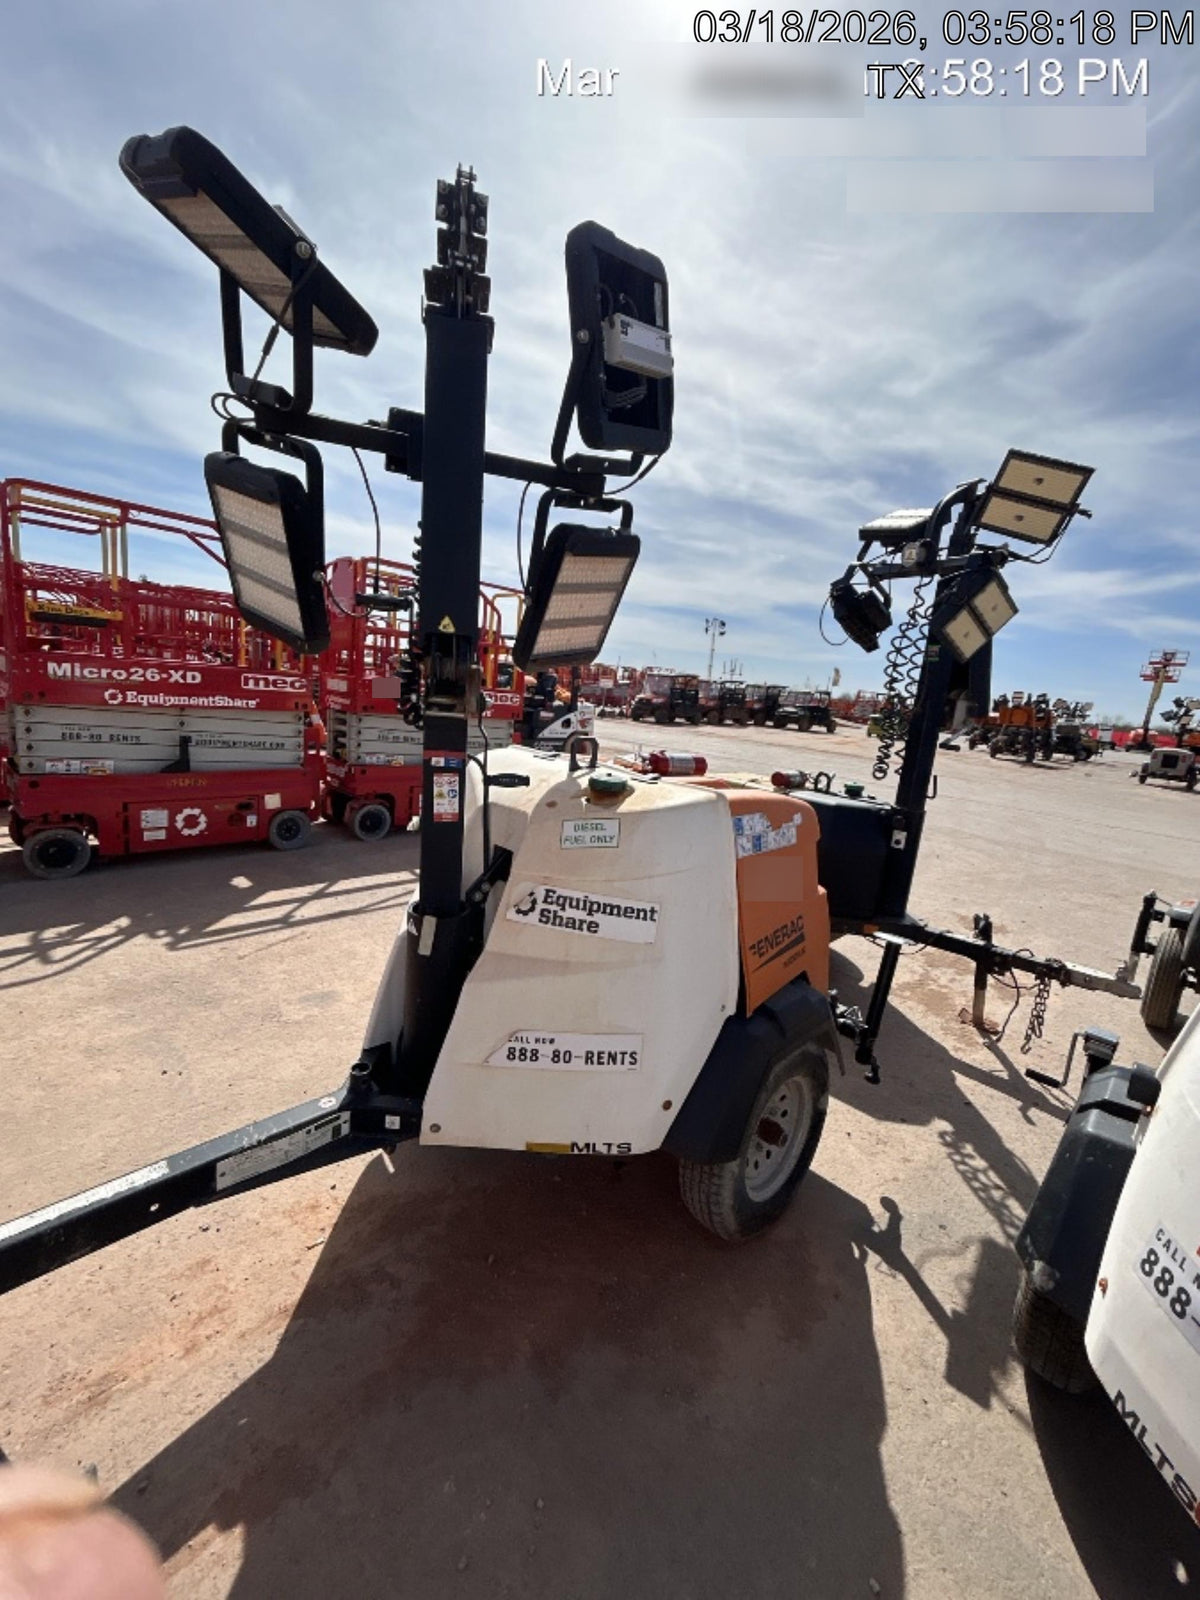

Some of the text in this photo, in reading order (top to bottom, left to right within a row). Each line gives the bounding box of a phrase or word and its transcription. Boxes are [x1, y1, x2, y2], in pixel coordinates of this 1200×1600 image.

[47, 661, 202, 684] Micro26-XD
[242, 674, 307, 692] mec
[126, 690, 257, 708] EquipmentShare
[573, 821, 607, 833] DIESEL
[589, 834, 616, 844] ONLY
[541, 888, 658, 922] Equipment
[538, 907, 600, 934] Share
[508, 1035, 530, 1044] ALL
[506, 1046, 638, 1066] 888-80-RENTS
[570, 1141, 633, 1155] MLTS
[1155, 1228, 1187, 1272] CALL
[1113, 1389, 1198, 1512] MLTS
